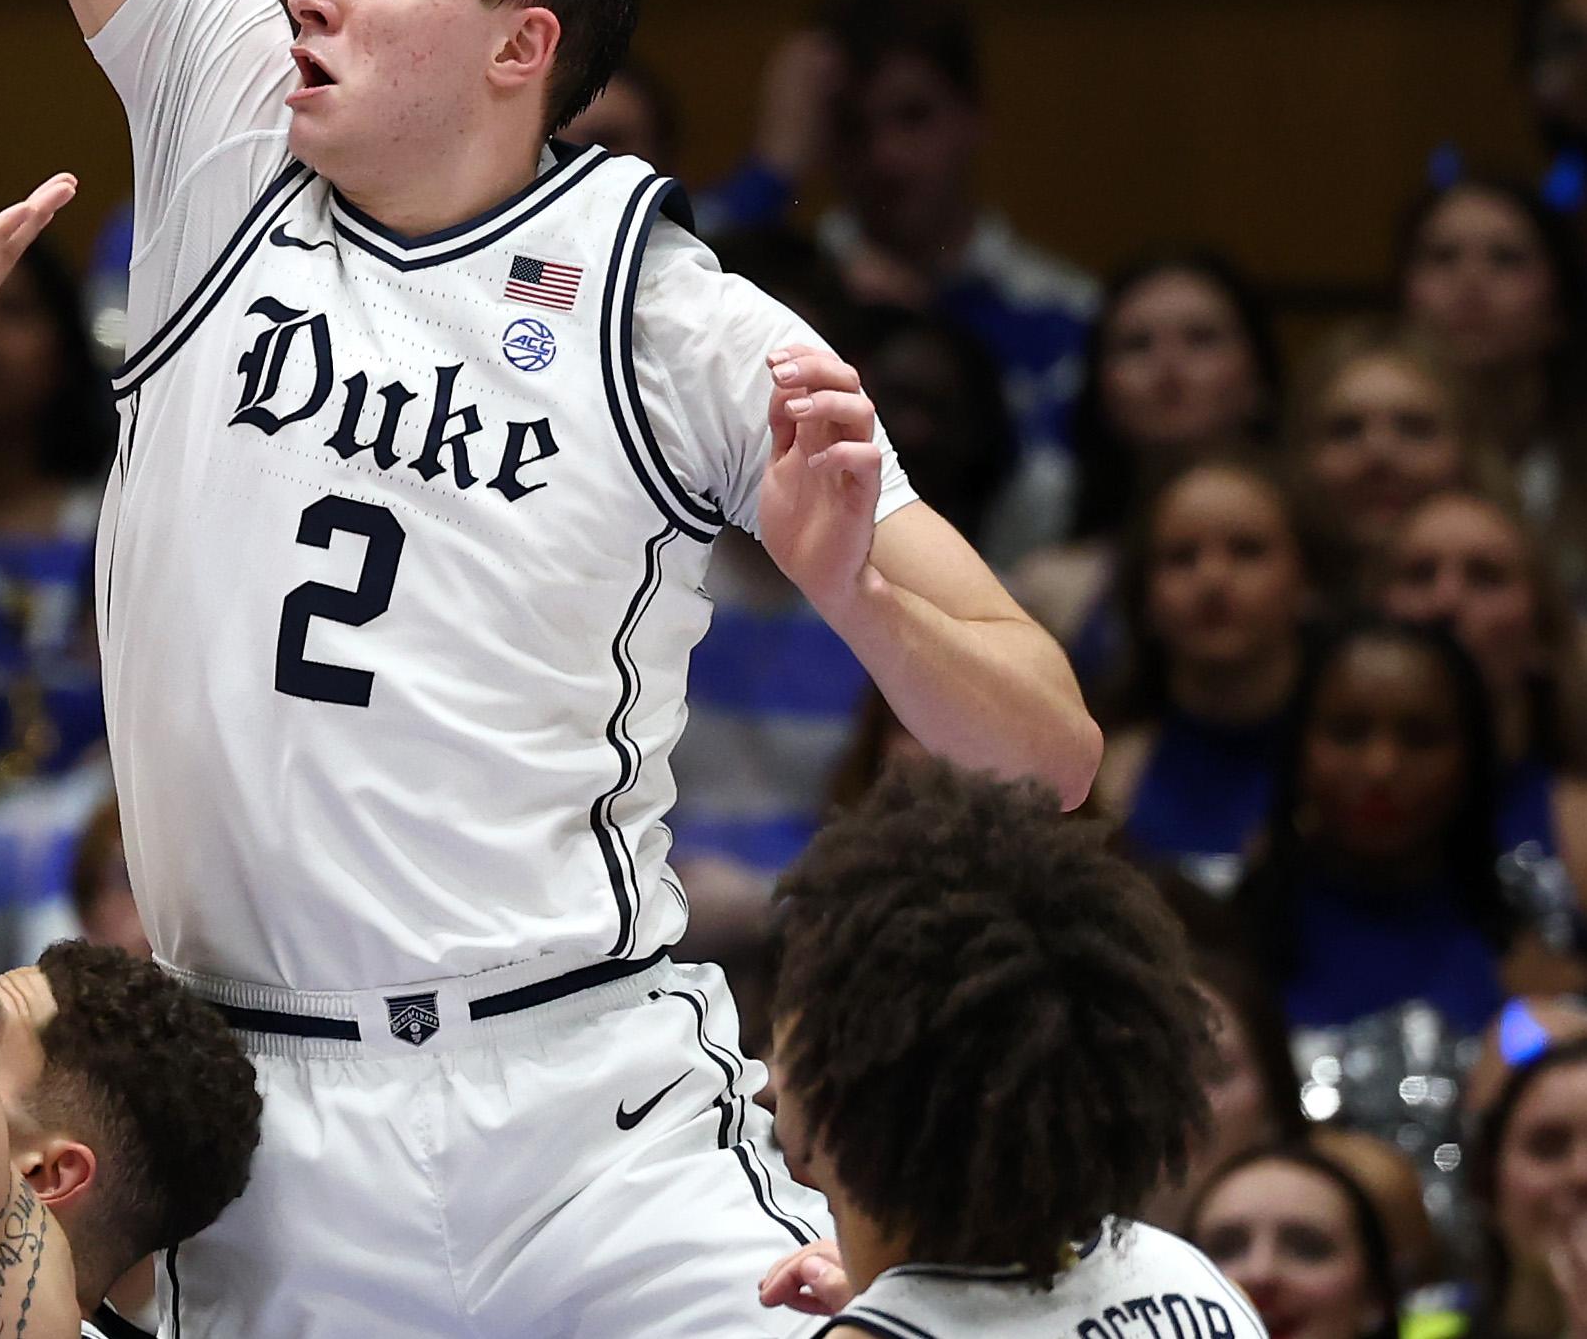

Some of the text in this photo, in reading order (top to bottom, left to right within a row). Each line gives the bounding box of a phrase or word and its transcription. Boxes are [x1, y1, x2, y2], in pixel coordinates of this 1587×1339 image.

[227, 295, 560, 503] Duke
[509, 335, 555, 356] ACC
[274, 494, 407, 708] 2
